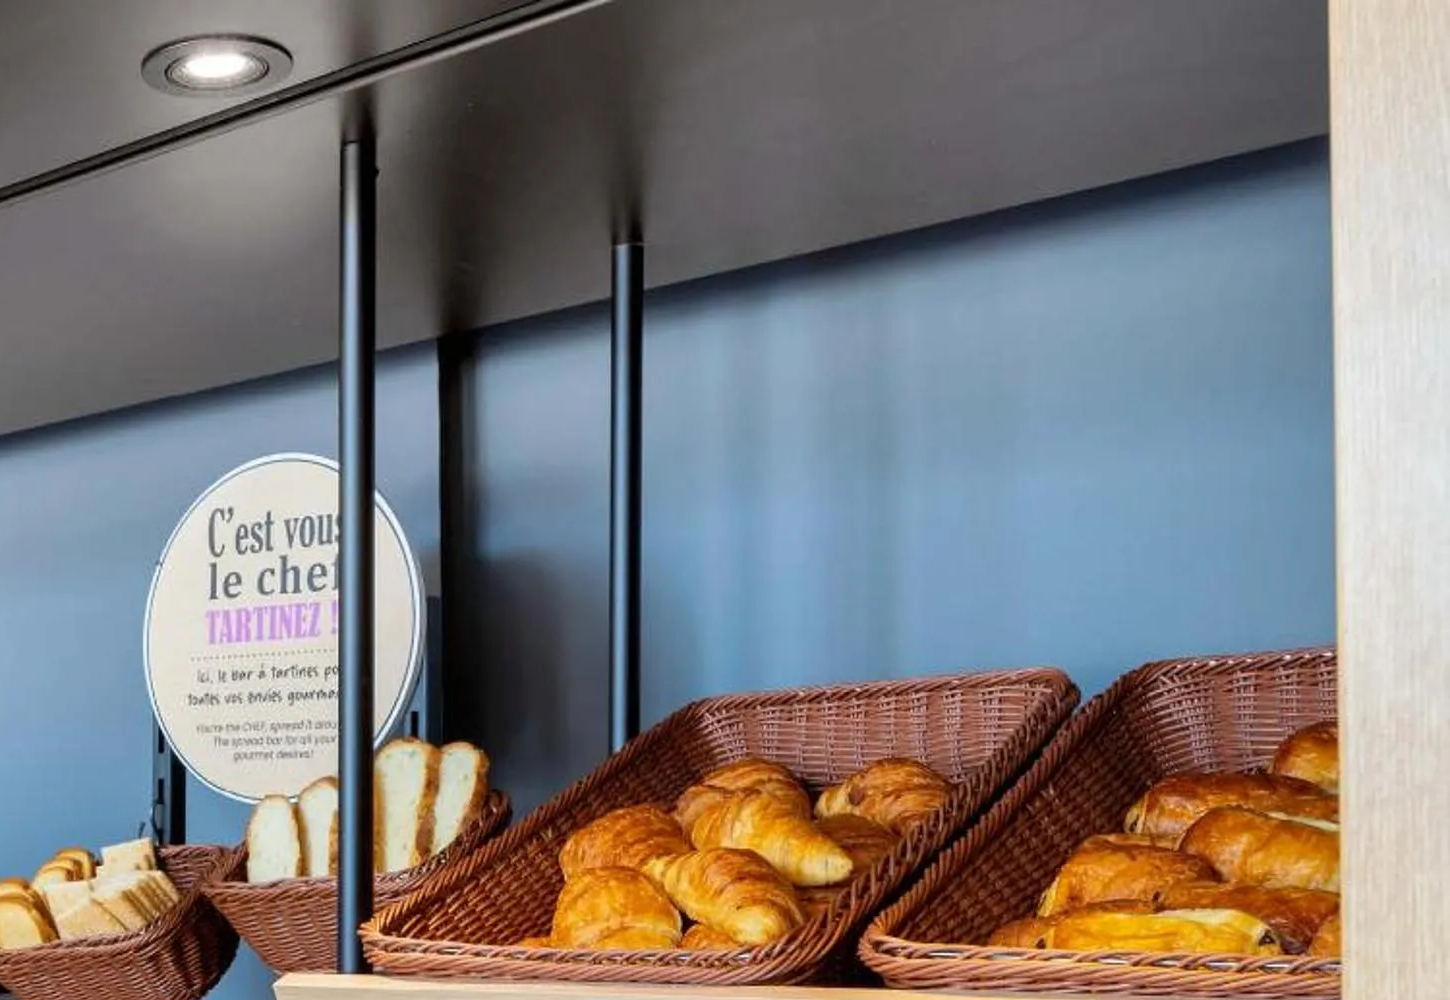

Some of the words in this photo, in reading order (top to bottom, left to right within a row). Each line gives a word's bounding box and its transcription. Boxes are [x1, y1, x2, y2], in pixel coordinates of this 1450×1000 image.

[208, 506, 275, 557] C'est
[208, 561, 242, 600] le
[205, 602, 321, 645] TARTINEZ
[218, 669, 227, 683] le
[231, 668, 253, 681] bar
[271, 664, 319, 680] tartines
[324, 665, 339, 682] po
[187, 692, 221, 706] toutes
[224, 693, 243, 705] vos
[247, 688, 283, 705] envies
[226, 722, 241, 733] the
[270, 720, 304, 735] spread
[214, 736, 229, 748] The
[233, 749, 275, 762] gourmet
